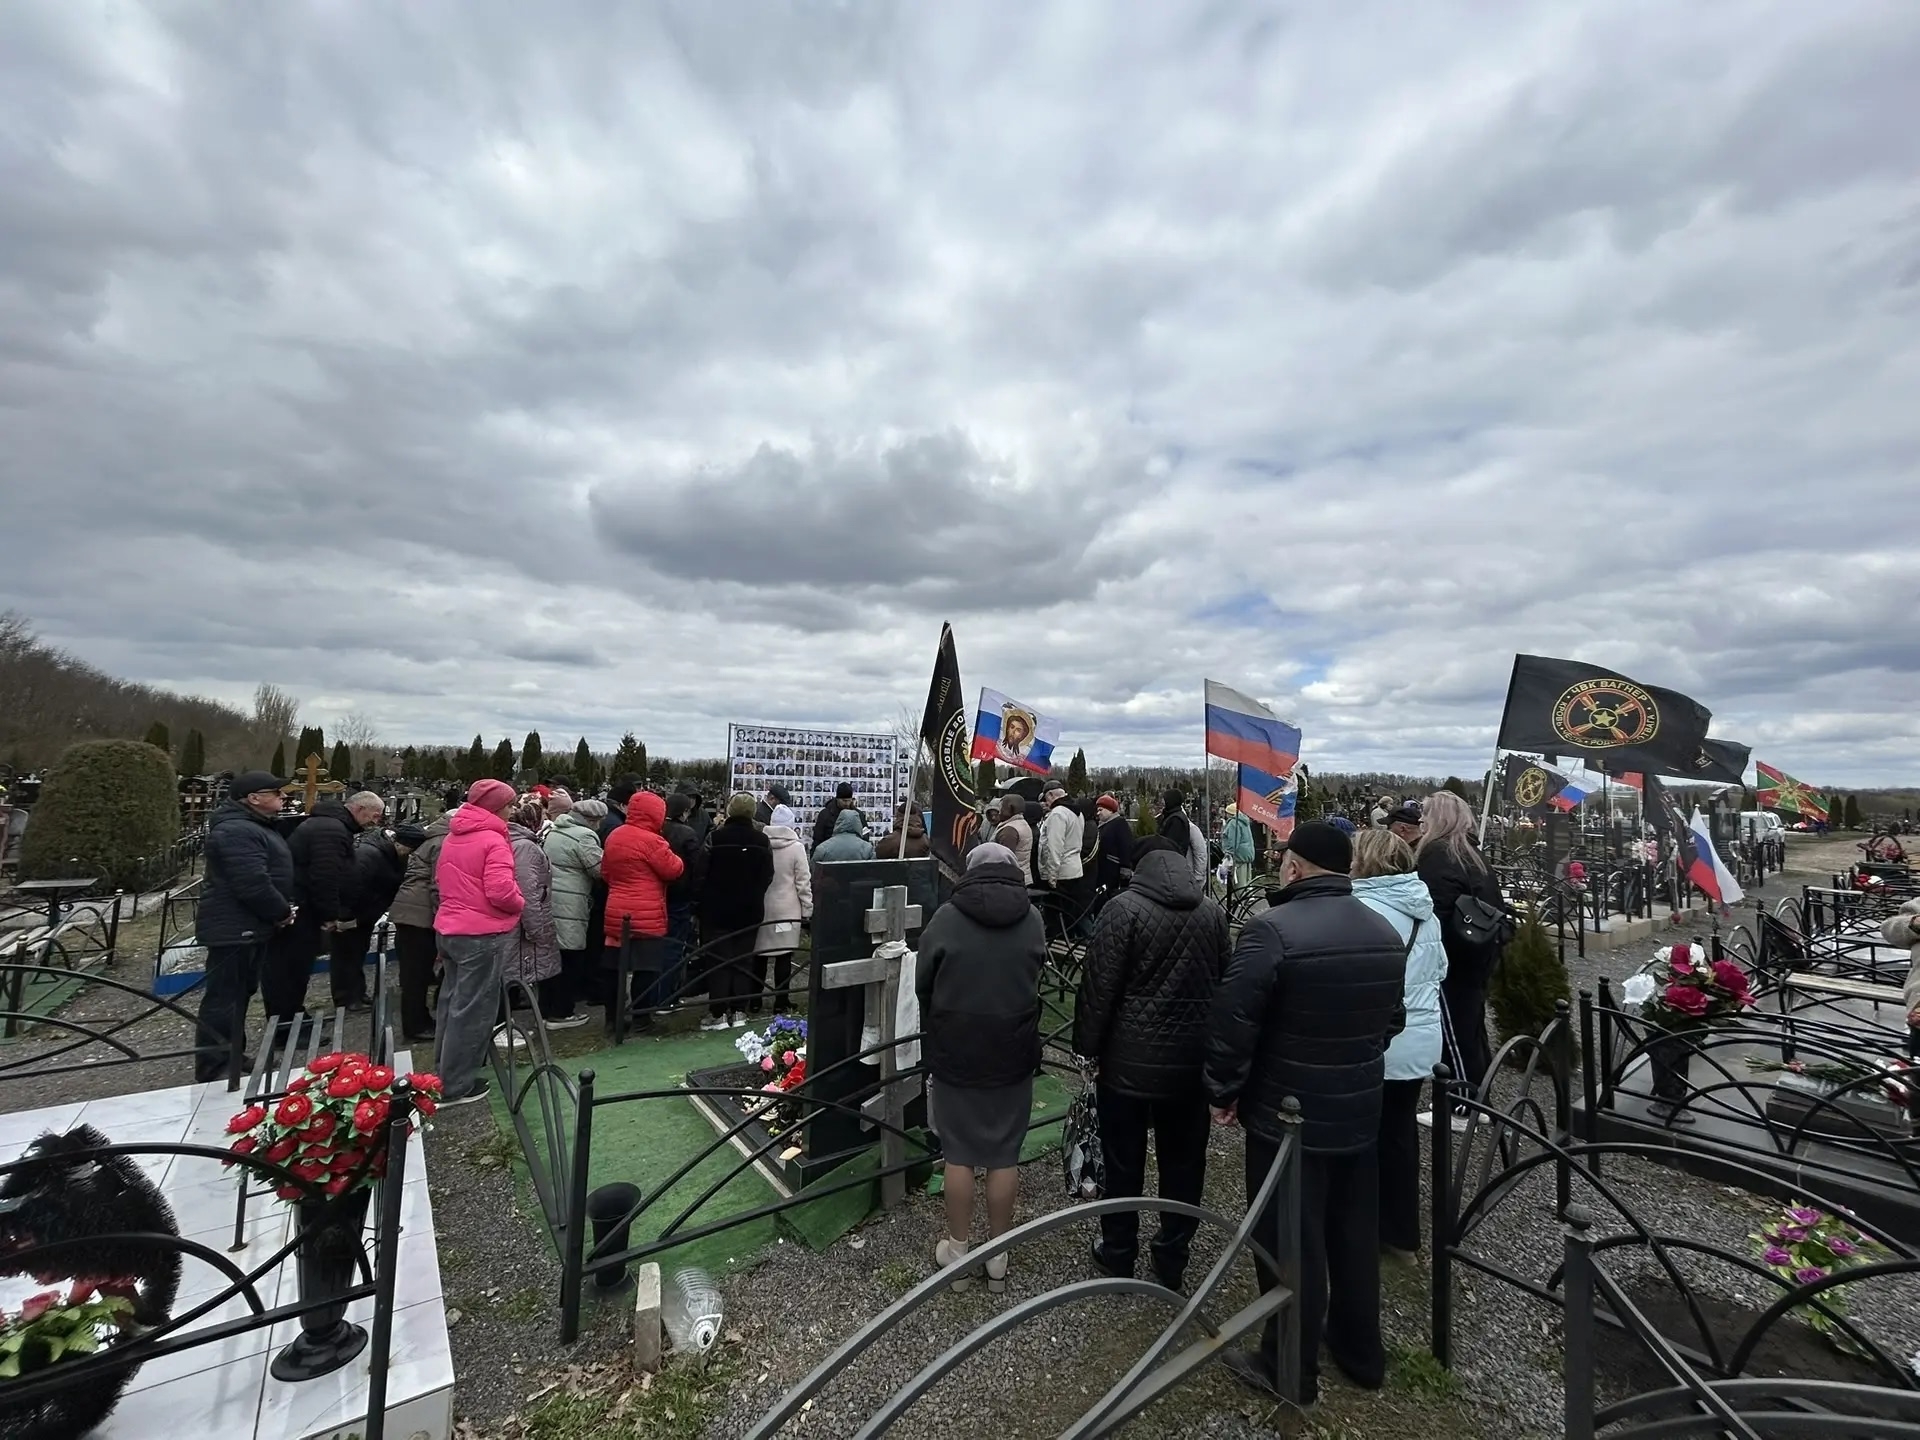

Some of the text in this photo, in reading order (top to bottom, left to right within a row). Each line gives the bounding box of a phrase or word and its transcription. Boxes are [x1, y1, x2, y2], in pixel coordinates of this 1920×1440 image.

[1571, 680, 1648, 701] ЧВК ВАГНЕР
[1556, 701, 1567, 727] КРОВЬ
[943, 729, 960, 793] ТАНКОВЫЕ
